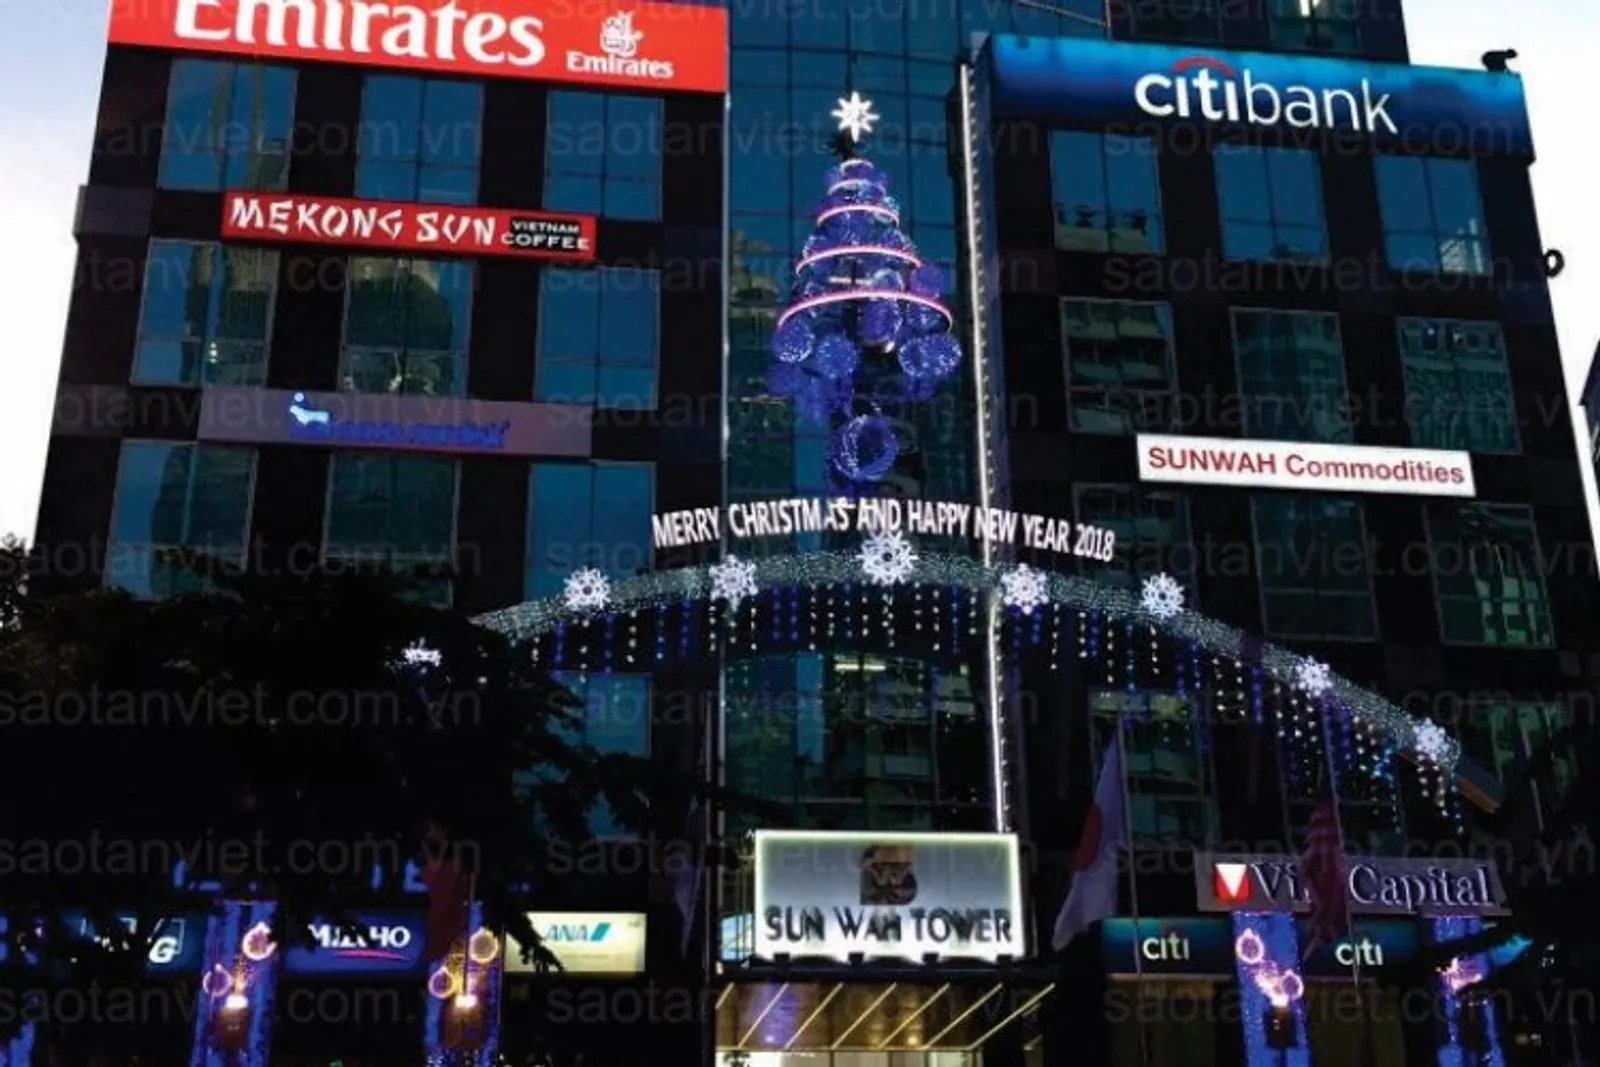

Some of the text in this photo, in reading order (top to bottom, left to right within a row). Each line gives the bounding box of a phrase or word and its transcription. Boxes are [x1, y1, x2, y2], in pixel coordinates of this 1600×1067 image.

[174, 0, 545, 66] Emirates
[566, 50, 675, 79] Emirates
[1134, 67, 1398, 134] citibank
[229, 196, 496, 246] MEKONG SUN
[501, 231, 590, 250] COFFEE
[512, 219, 580, 233] VIETNAM
[1149, 446, 1466, 485] SUNWAH Commodities
[652, 497, 1115, 563] MERRY CHRISTMAS AND HAPPY NEW YEAR 2018
[1349, 863, 1493, 912] Capital
[765, 905, 1013, 944] SUN WAH TOWER
[1143, 931, 1190, 961] citi
[1335, 938, 1384, 967] citi
